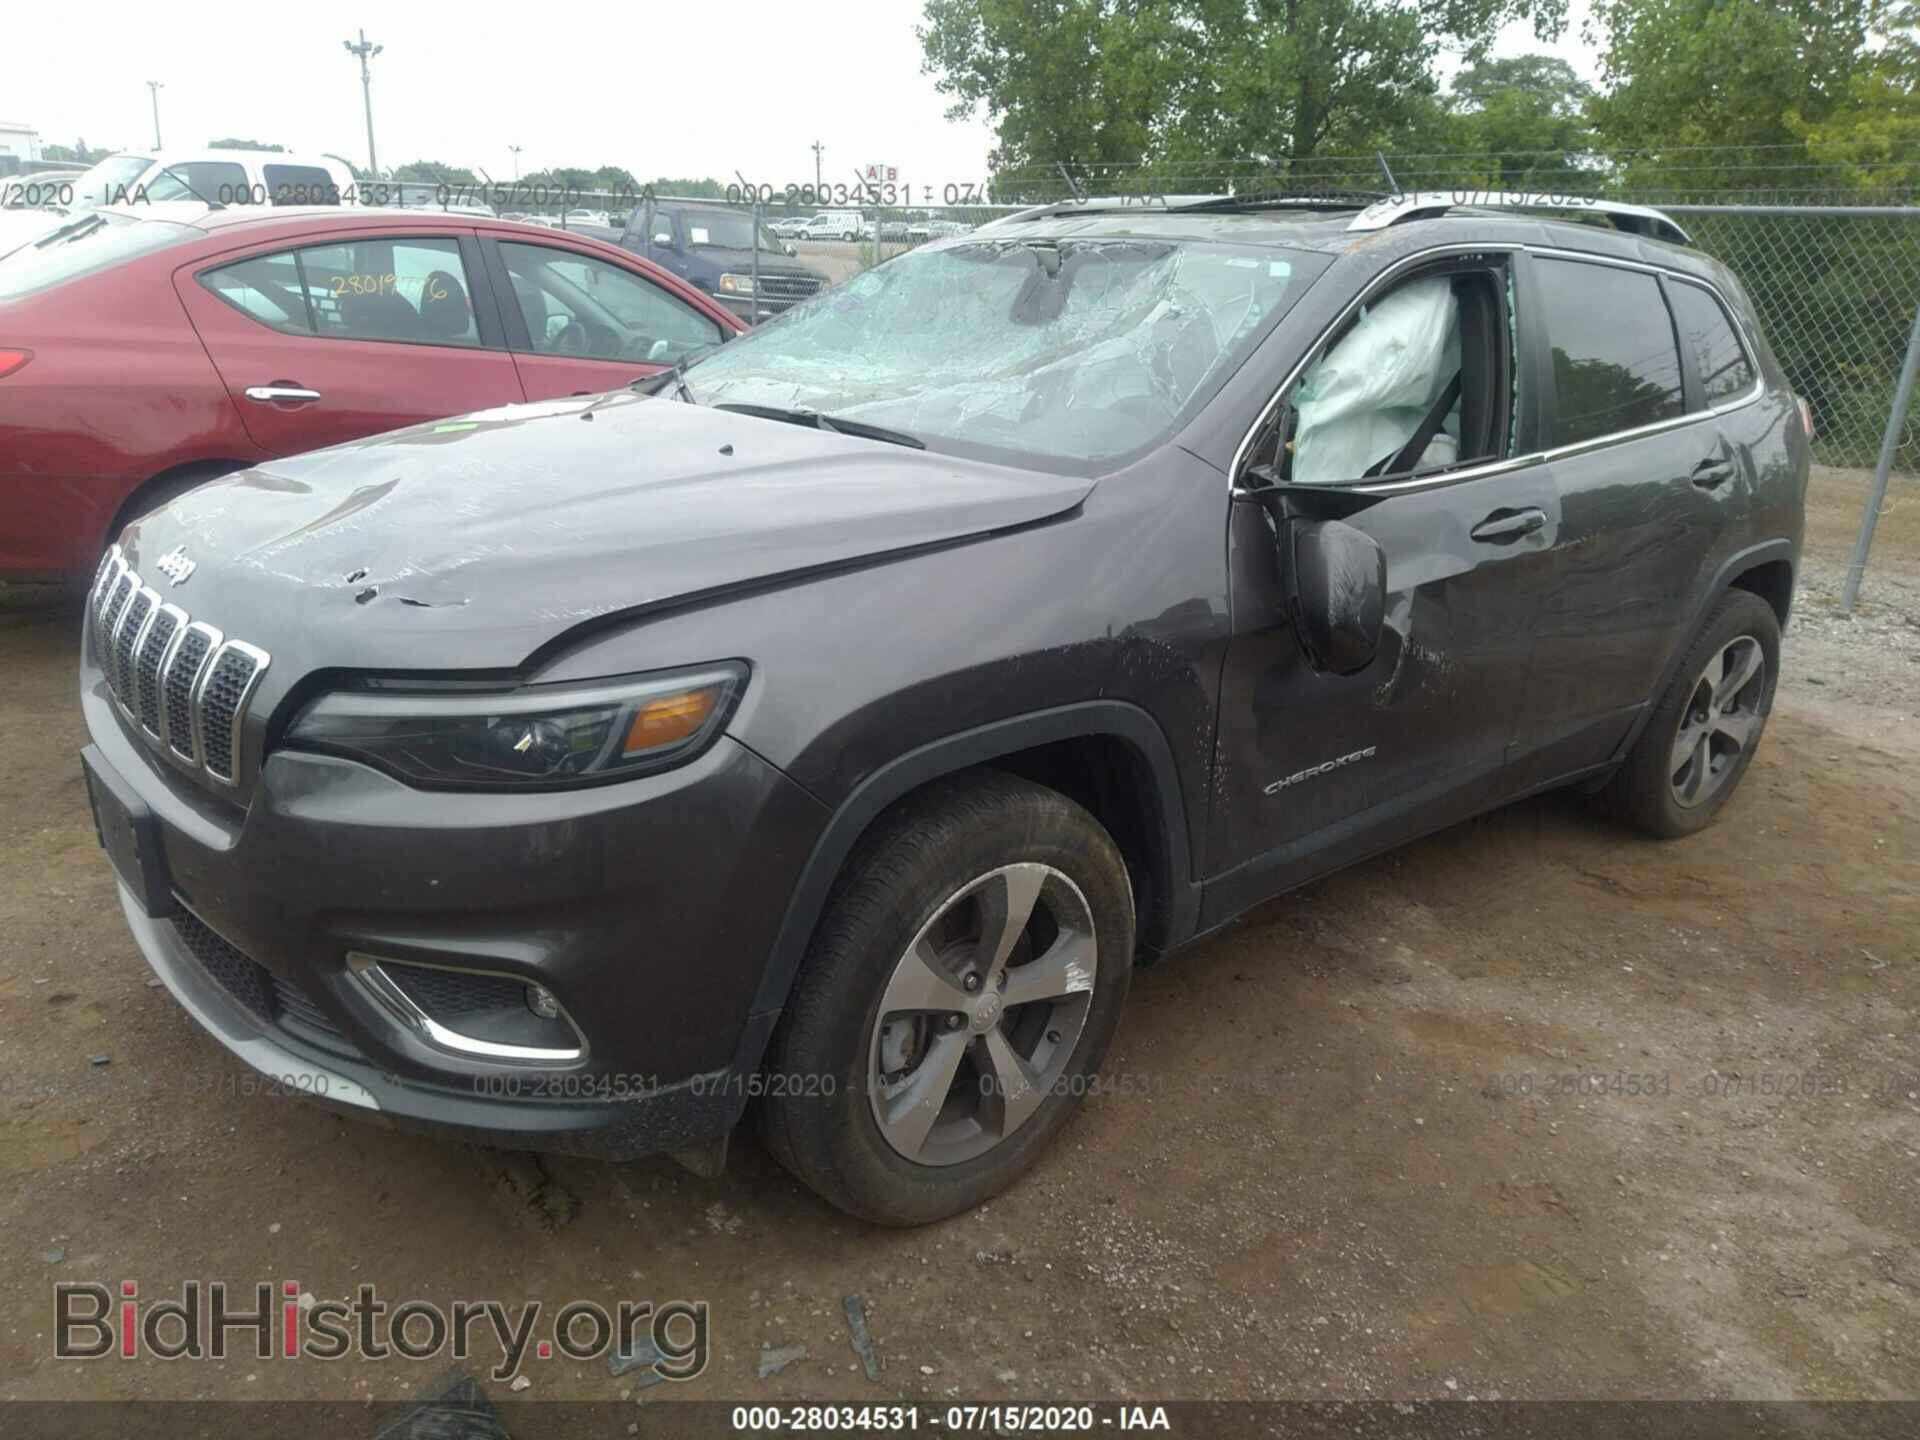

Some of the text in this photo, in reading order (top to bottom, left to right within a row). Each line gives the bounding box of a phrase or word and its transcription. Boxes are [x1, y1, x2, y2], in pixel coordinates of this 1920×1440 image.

[867, 165, 878, 180] A
[887, 167, 898, 181] B
[1264, 746, 1376, 795] CHEROKEE
